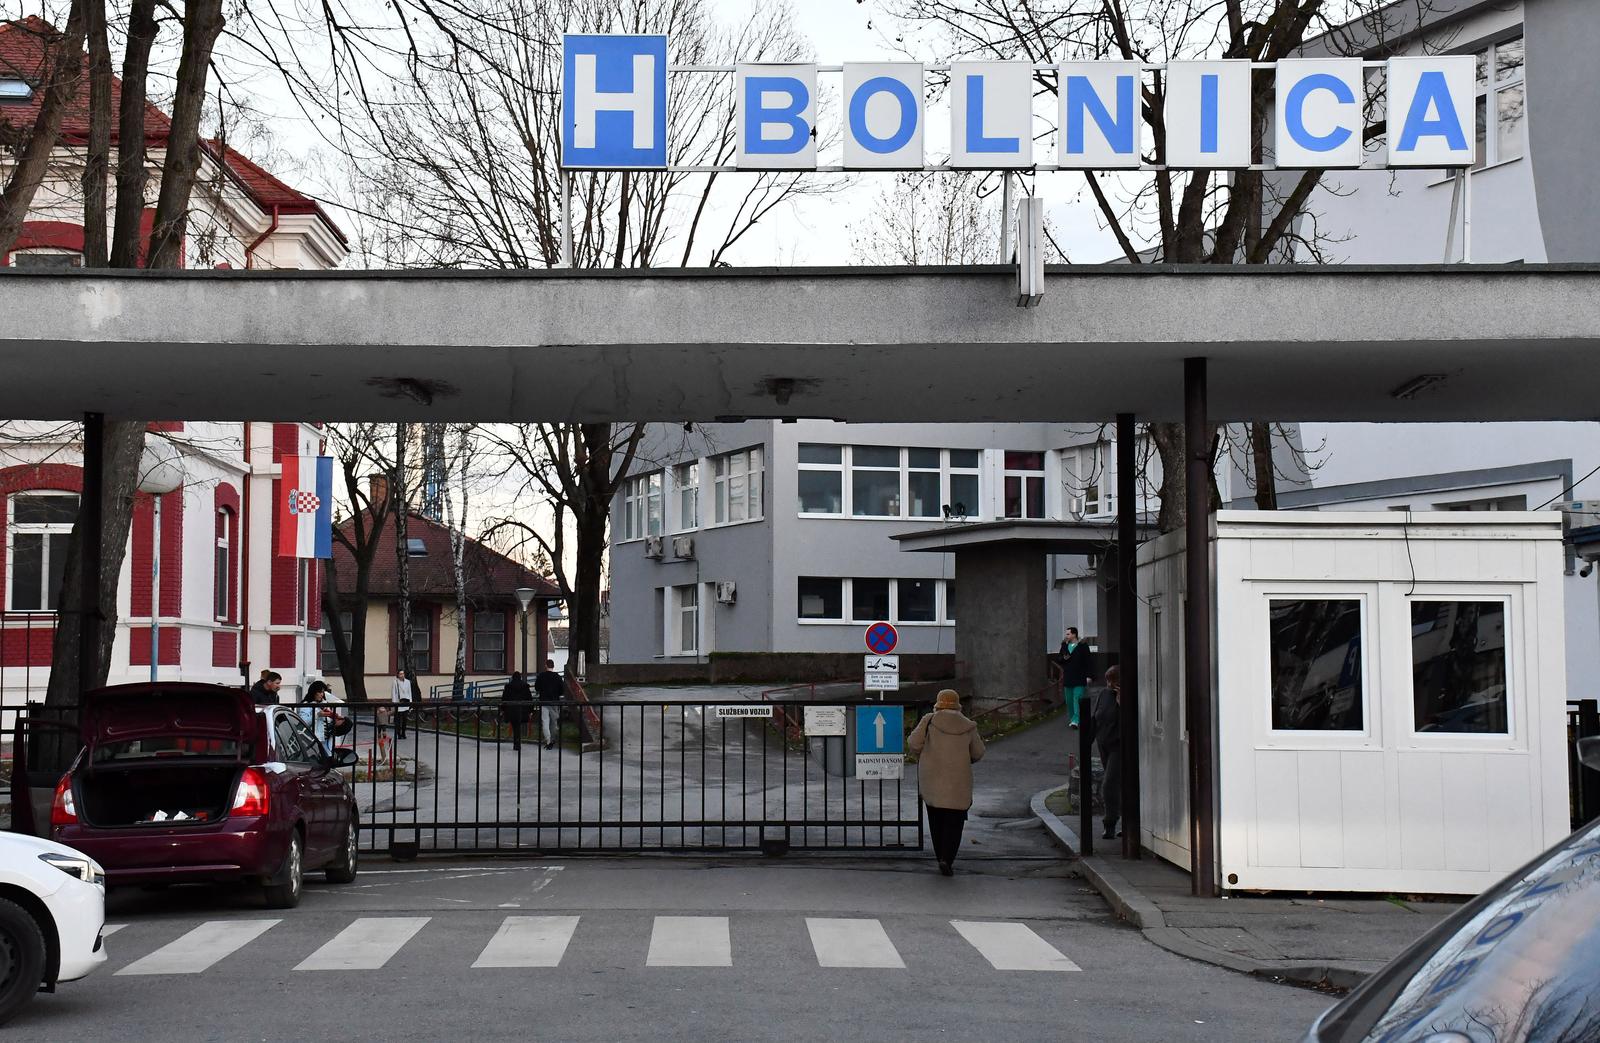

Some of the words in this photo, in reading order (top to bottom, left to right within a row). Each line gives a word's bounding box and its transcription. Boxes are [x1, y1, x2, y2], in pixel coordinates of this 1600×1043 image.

[574, 54, 654, 150] H
[745, 71, 1469, 154] BOLNICA
[718, 707, 749, 716] SLUŽBENO
[750, 708, 770, 716] VOZILO
